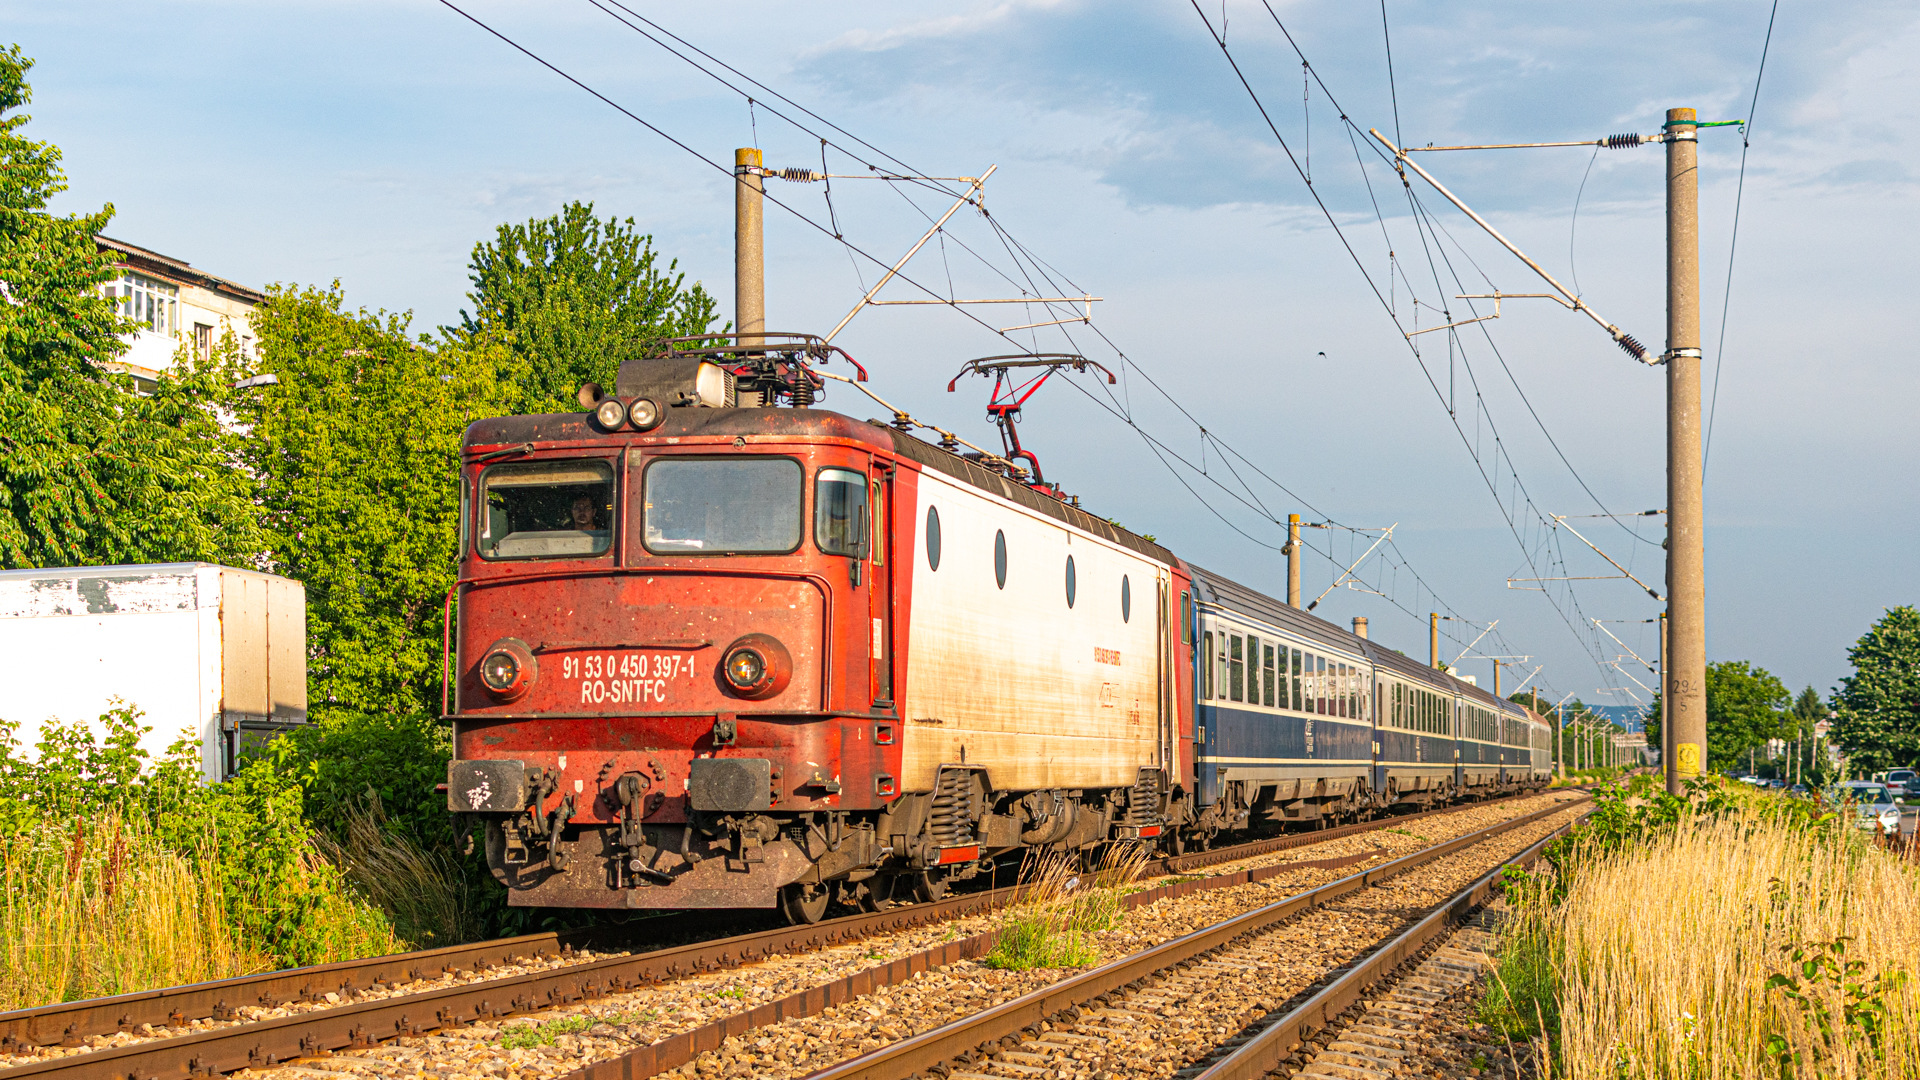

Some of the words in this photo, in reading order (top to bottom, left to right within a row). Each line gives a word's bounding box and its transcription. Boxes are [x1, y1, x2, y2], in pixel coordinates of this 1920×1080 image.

[563, 656, 578, 678] 91
[585, 655, 602, 678] 53
[607, 655, 616, 678] 0
[620, 655, 648, 678] 450
[653, 655, 695, 678] 397-1
[581, 679, 666, 703] RO-SNTFC
[1680, 701, 1688, 712] 5
